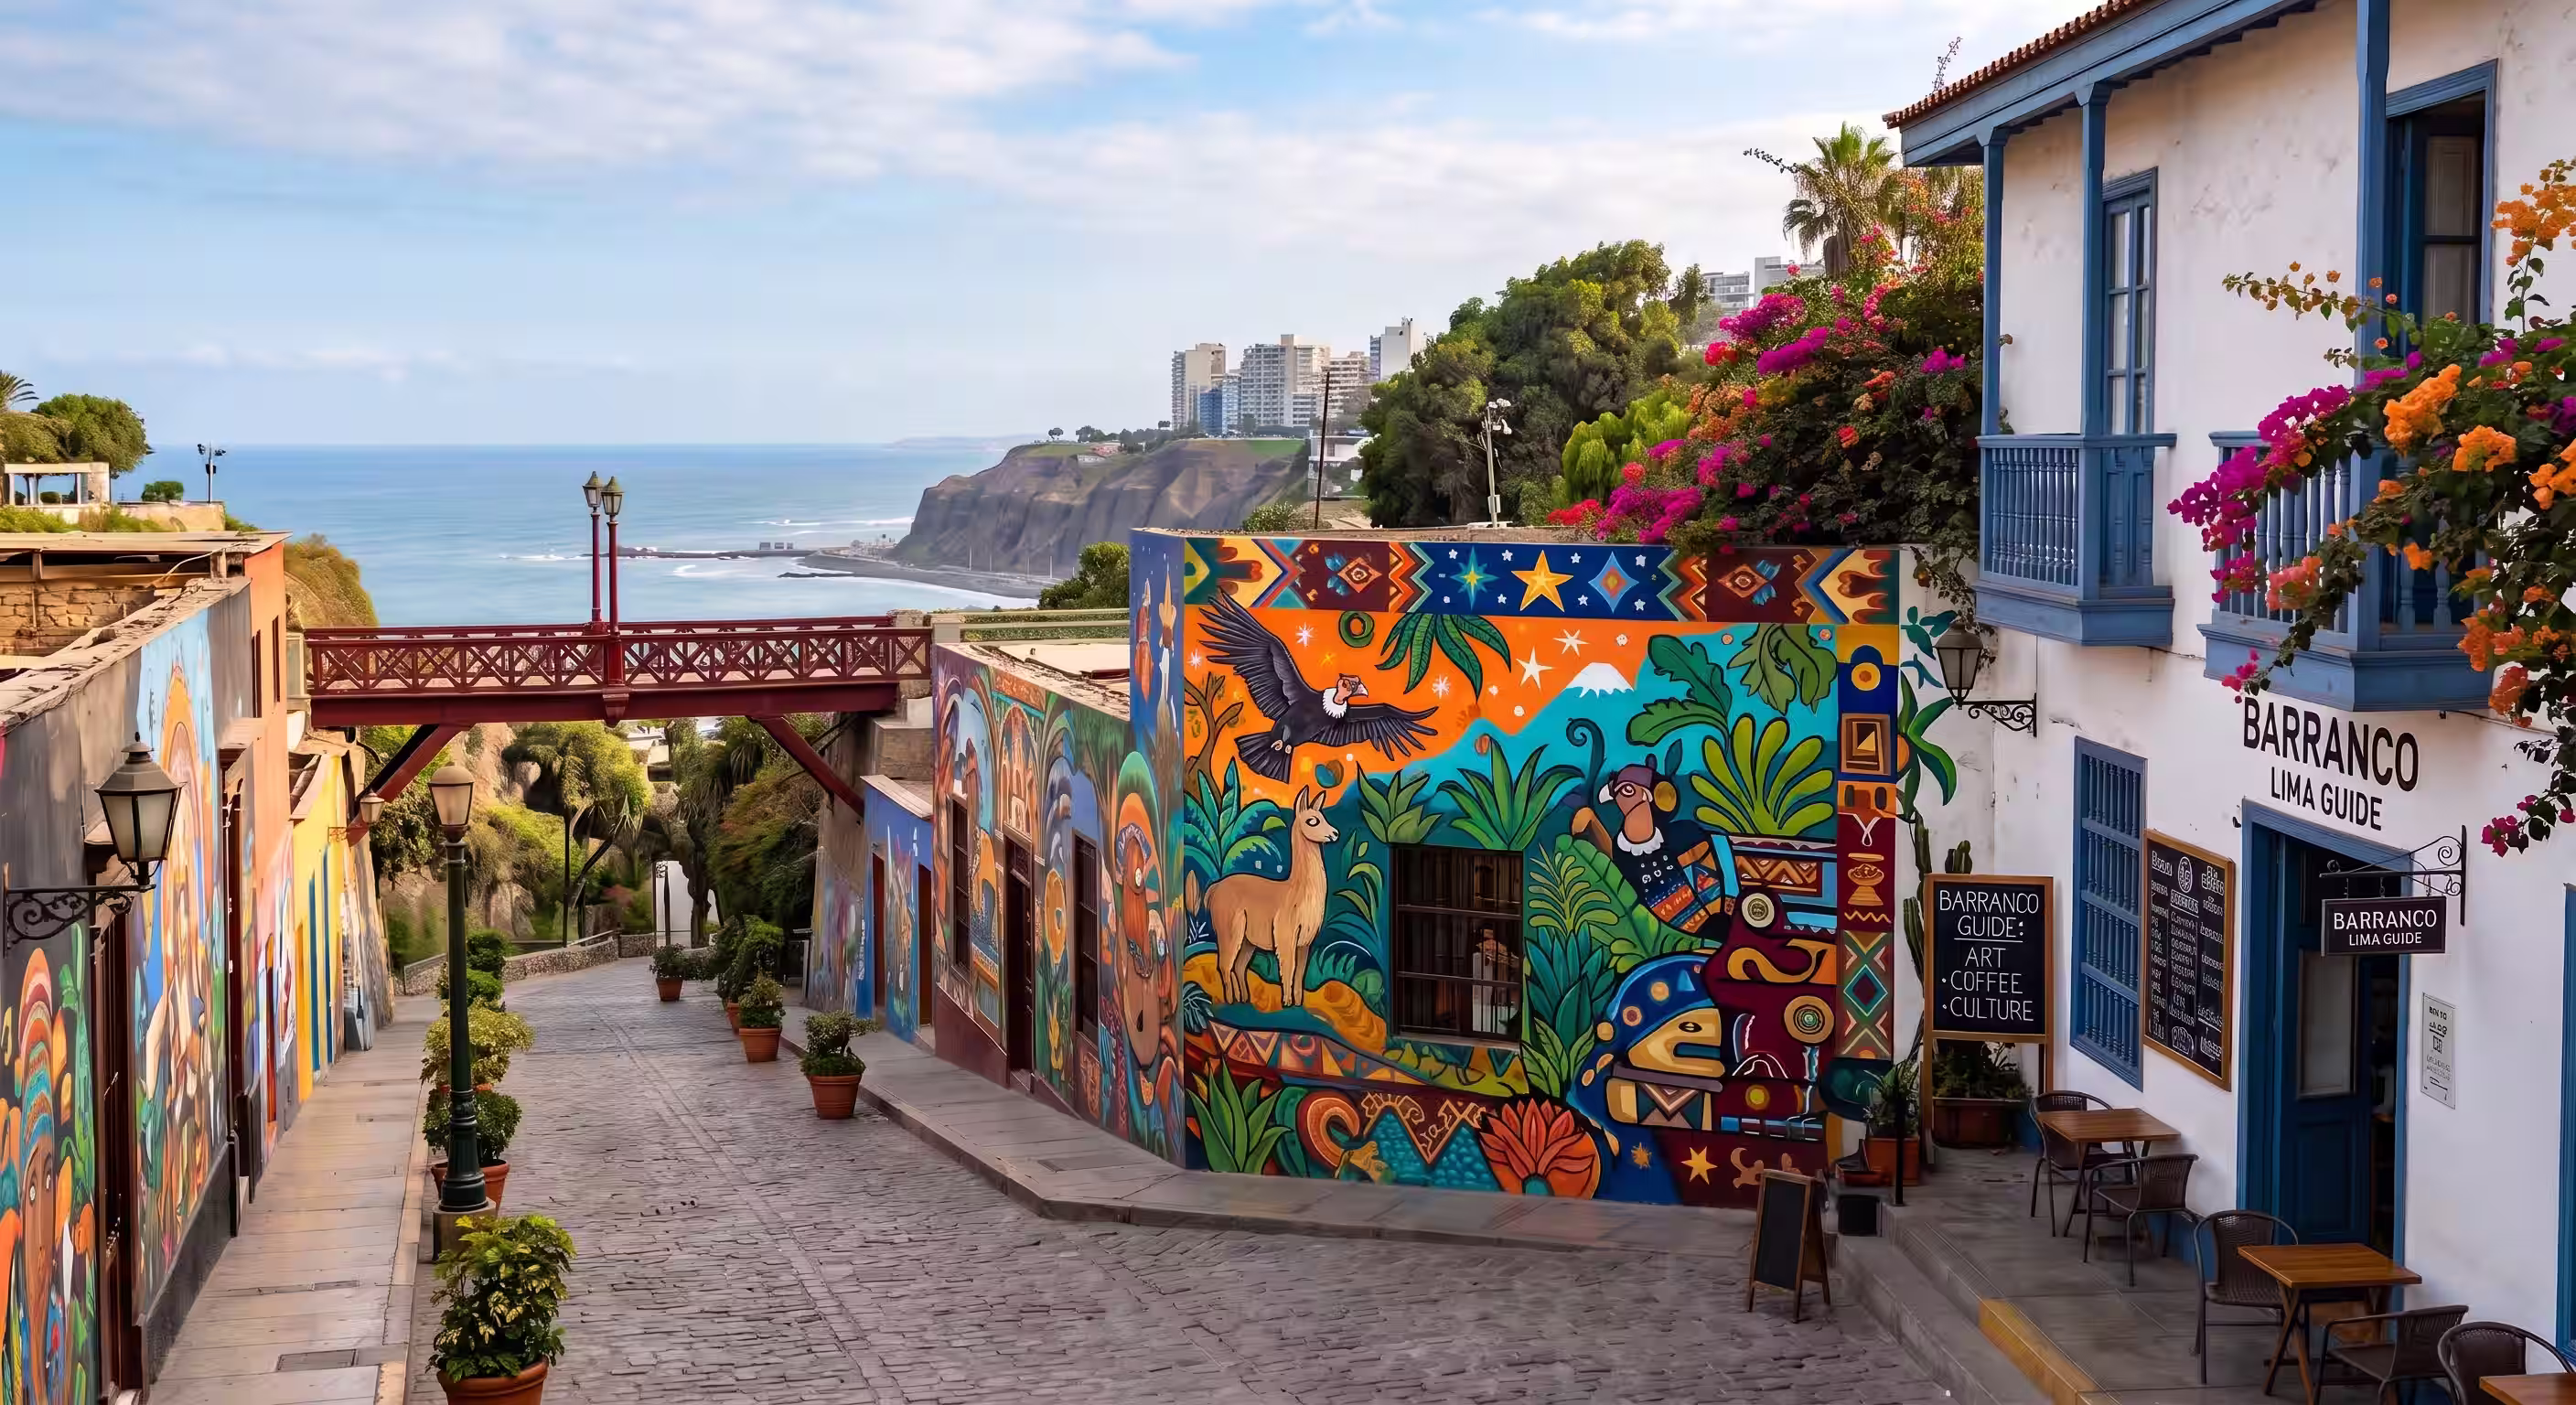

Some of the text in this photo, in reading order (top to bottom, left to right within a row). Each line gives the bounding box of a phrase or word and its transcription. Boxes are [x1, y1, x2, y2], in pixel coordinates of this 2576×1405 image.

[2243, 696, 2420, 792] BARRANCO
[2270, 767, 2384, 831] LIMA GUIDE
[1939, 890, 2039, 914] BARRANCO
[1958, 916, 2024, 938] GUIDE:
[2334, 909, 2438, 930] BARRANCO
[2348, 931, 2423, 946] LIMA GUIDE
[1964, 947, 2007, 969] ART
[1949, 971, 2024, 995] COFFEE
[1948, 996, 2034, 1022] CULTURE
